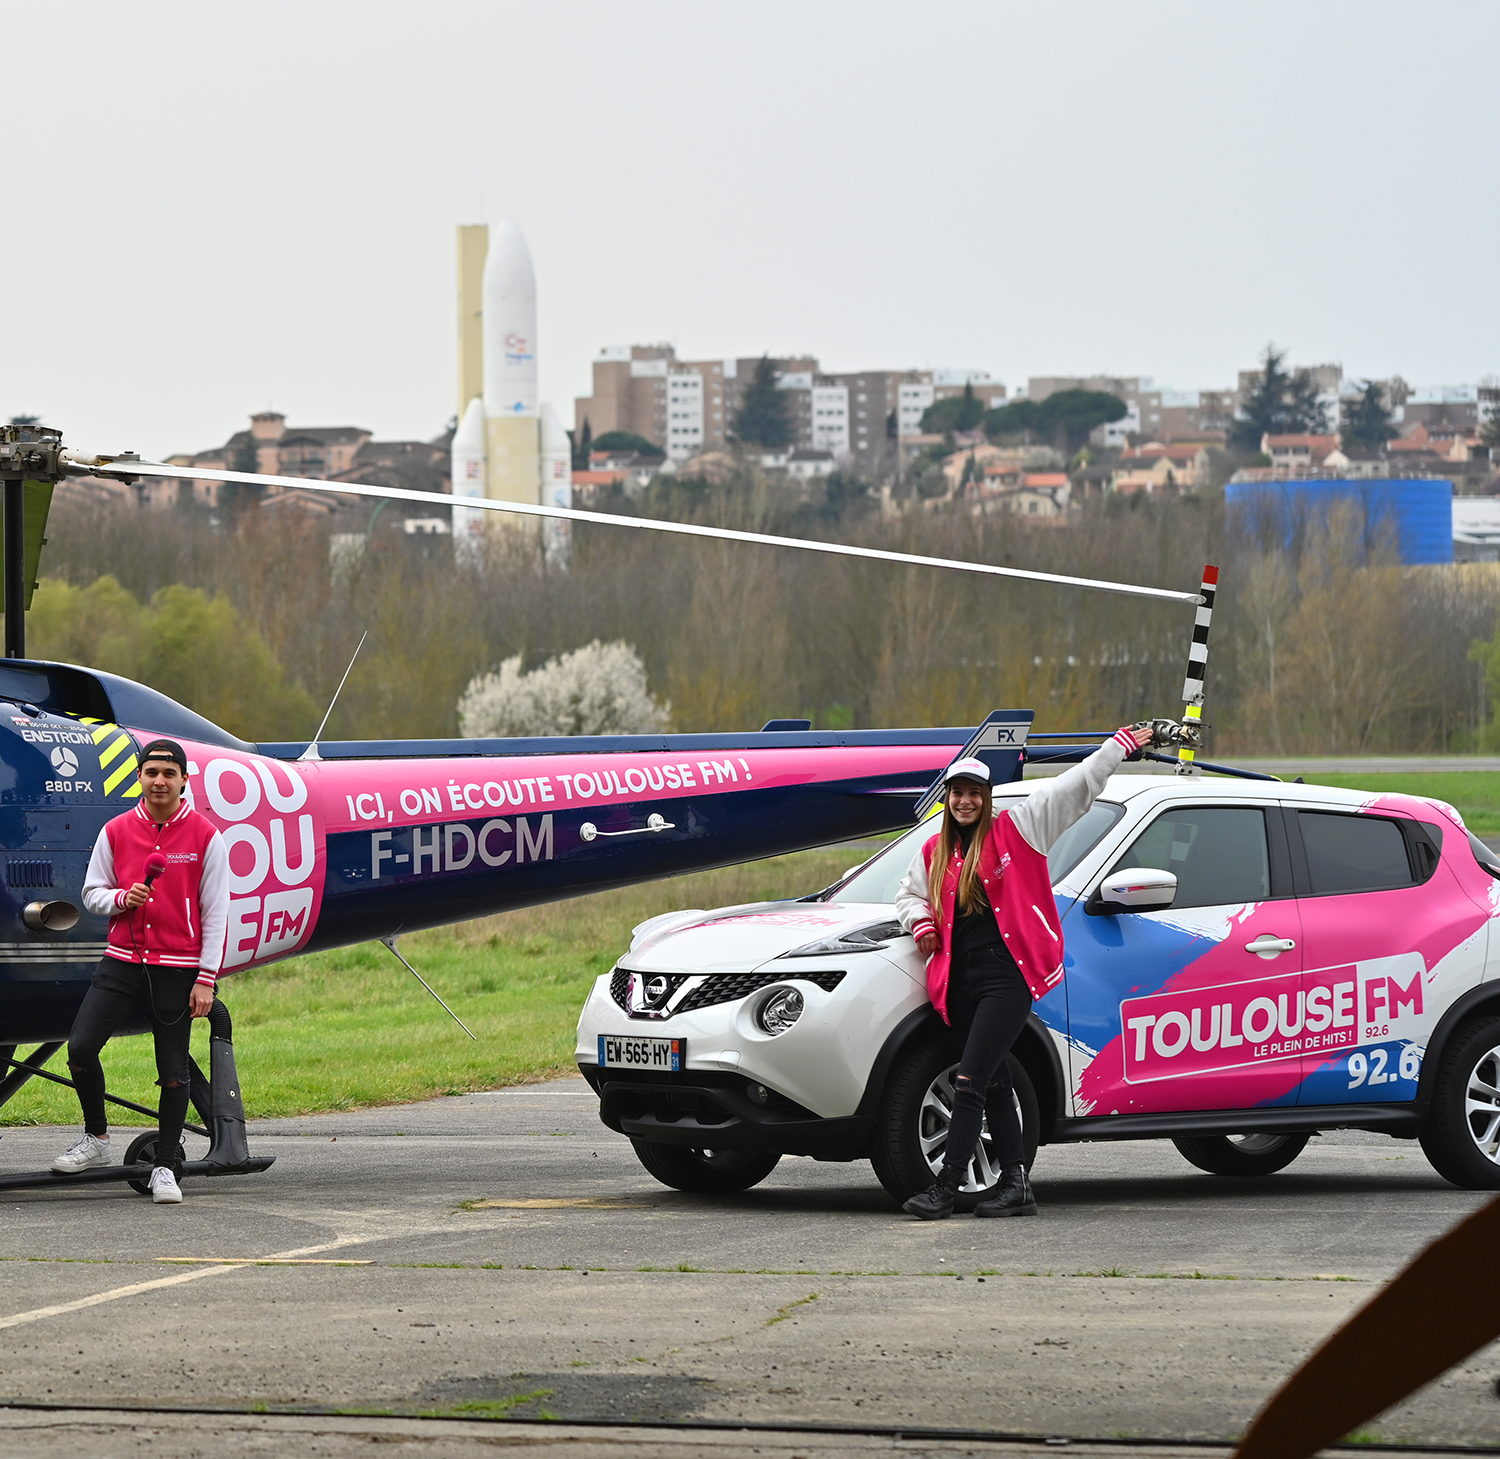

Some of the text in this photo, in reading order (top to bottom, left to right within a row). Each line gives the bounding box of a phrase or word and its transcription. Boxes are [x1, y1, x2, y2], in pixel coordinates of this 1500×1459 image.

[20, 729, 93, 745] ENSTROM
[998, 729, 1015, 742] FX
[44, 780, 93, 792] 280 FX
[346, 792, 393, 822] ICI,
[400, 787, 442, 817] ON
[447, 777, 554, 811] ÉCOUTE
[556, 764, 696, 798] TOULOUSE
[696, 759, 737, 786] FM
[221, 814, 315, 895] OU
[372, 814, 553, 879] F-HDCM
[223, 896, 306, 968] E FM
[1128, 971, 1424, 1061] TOULOUSE FM
[1365, 1025, 1389, 1038] 92.6
[671, 1057, 679, 1067] 31
[1254, 1044, 1268, 1057] LE
[1270, 1039, 1302, 1054] PLEIN
[1304, 1037, 1320, 1050] DE
[1322, 1033, 1347, 1047] HITS
[1348, 1043, 1419, 1090] 92.6
